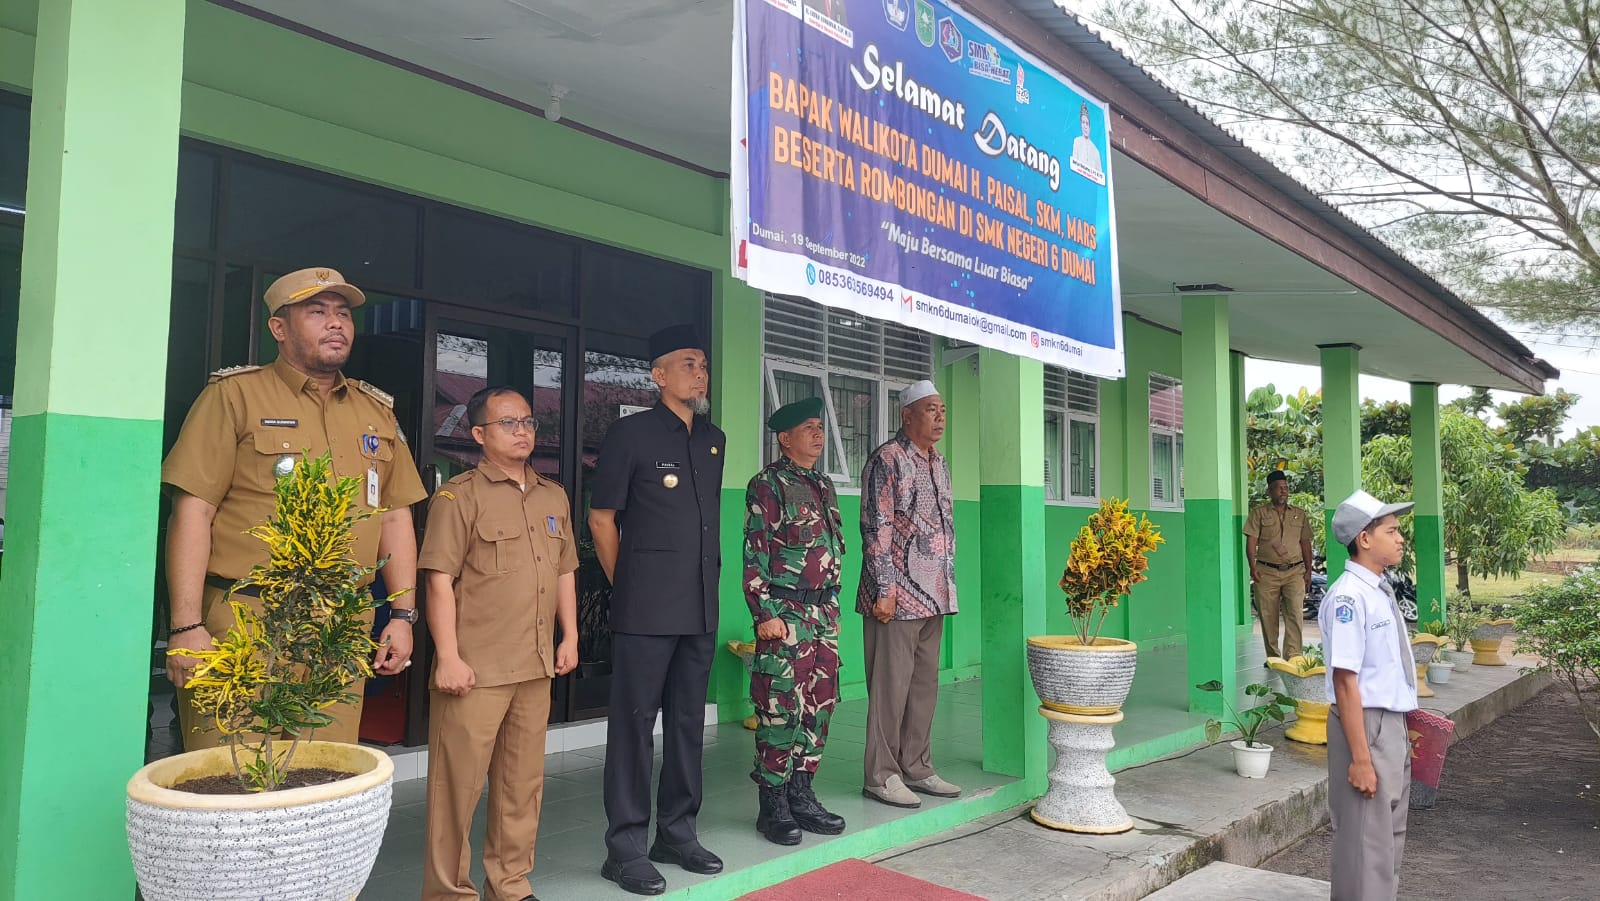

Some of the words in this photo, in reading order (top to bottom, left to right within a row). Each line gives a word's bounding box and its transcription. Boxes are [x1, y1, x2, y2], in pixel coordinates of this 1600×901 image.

[769, 70, 833, 133] BAPAK
[838, 102, 918, 172] WALIKOTA
[922, 143, 968, 195] DUMAI
[971, 167, 984, 201] H.
[987, 176, 1034, 227] PAISAL,
[1036, 199, 1065, 240] SKM,
[1066, 213, 1097, 251] MARS
[850, 44, 966, 131] Selamat
[974, 111, 1060, 192] Datang
[751, 221, 788, 245] Dumai,
[790, 231, 804, 246] 19
[805, 236, 849, 262] September
[849, 251, 867, 269] 2022
[774, 124, 856, 192] BESERTA
[860, 160, 956, 232] ROMBONGAN
[959, 204, 973, 238] DI
[975, 211, 1005, 250] SMK
[1007, 224, 1049, 267] NEGERI
[1051, 243, 1059, 273] 6
[1061, 247, 1096, 286] DUMAI
[920, 236, 972, 271] Bersama
[974, 255, 1000, 281] Luar
